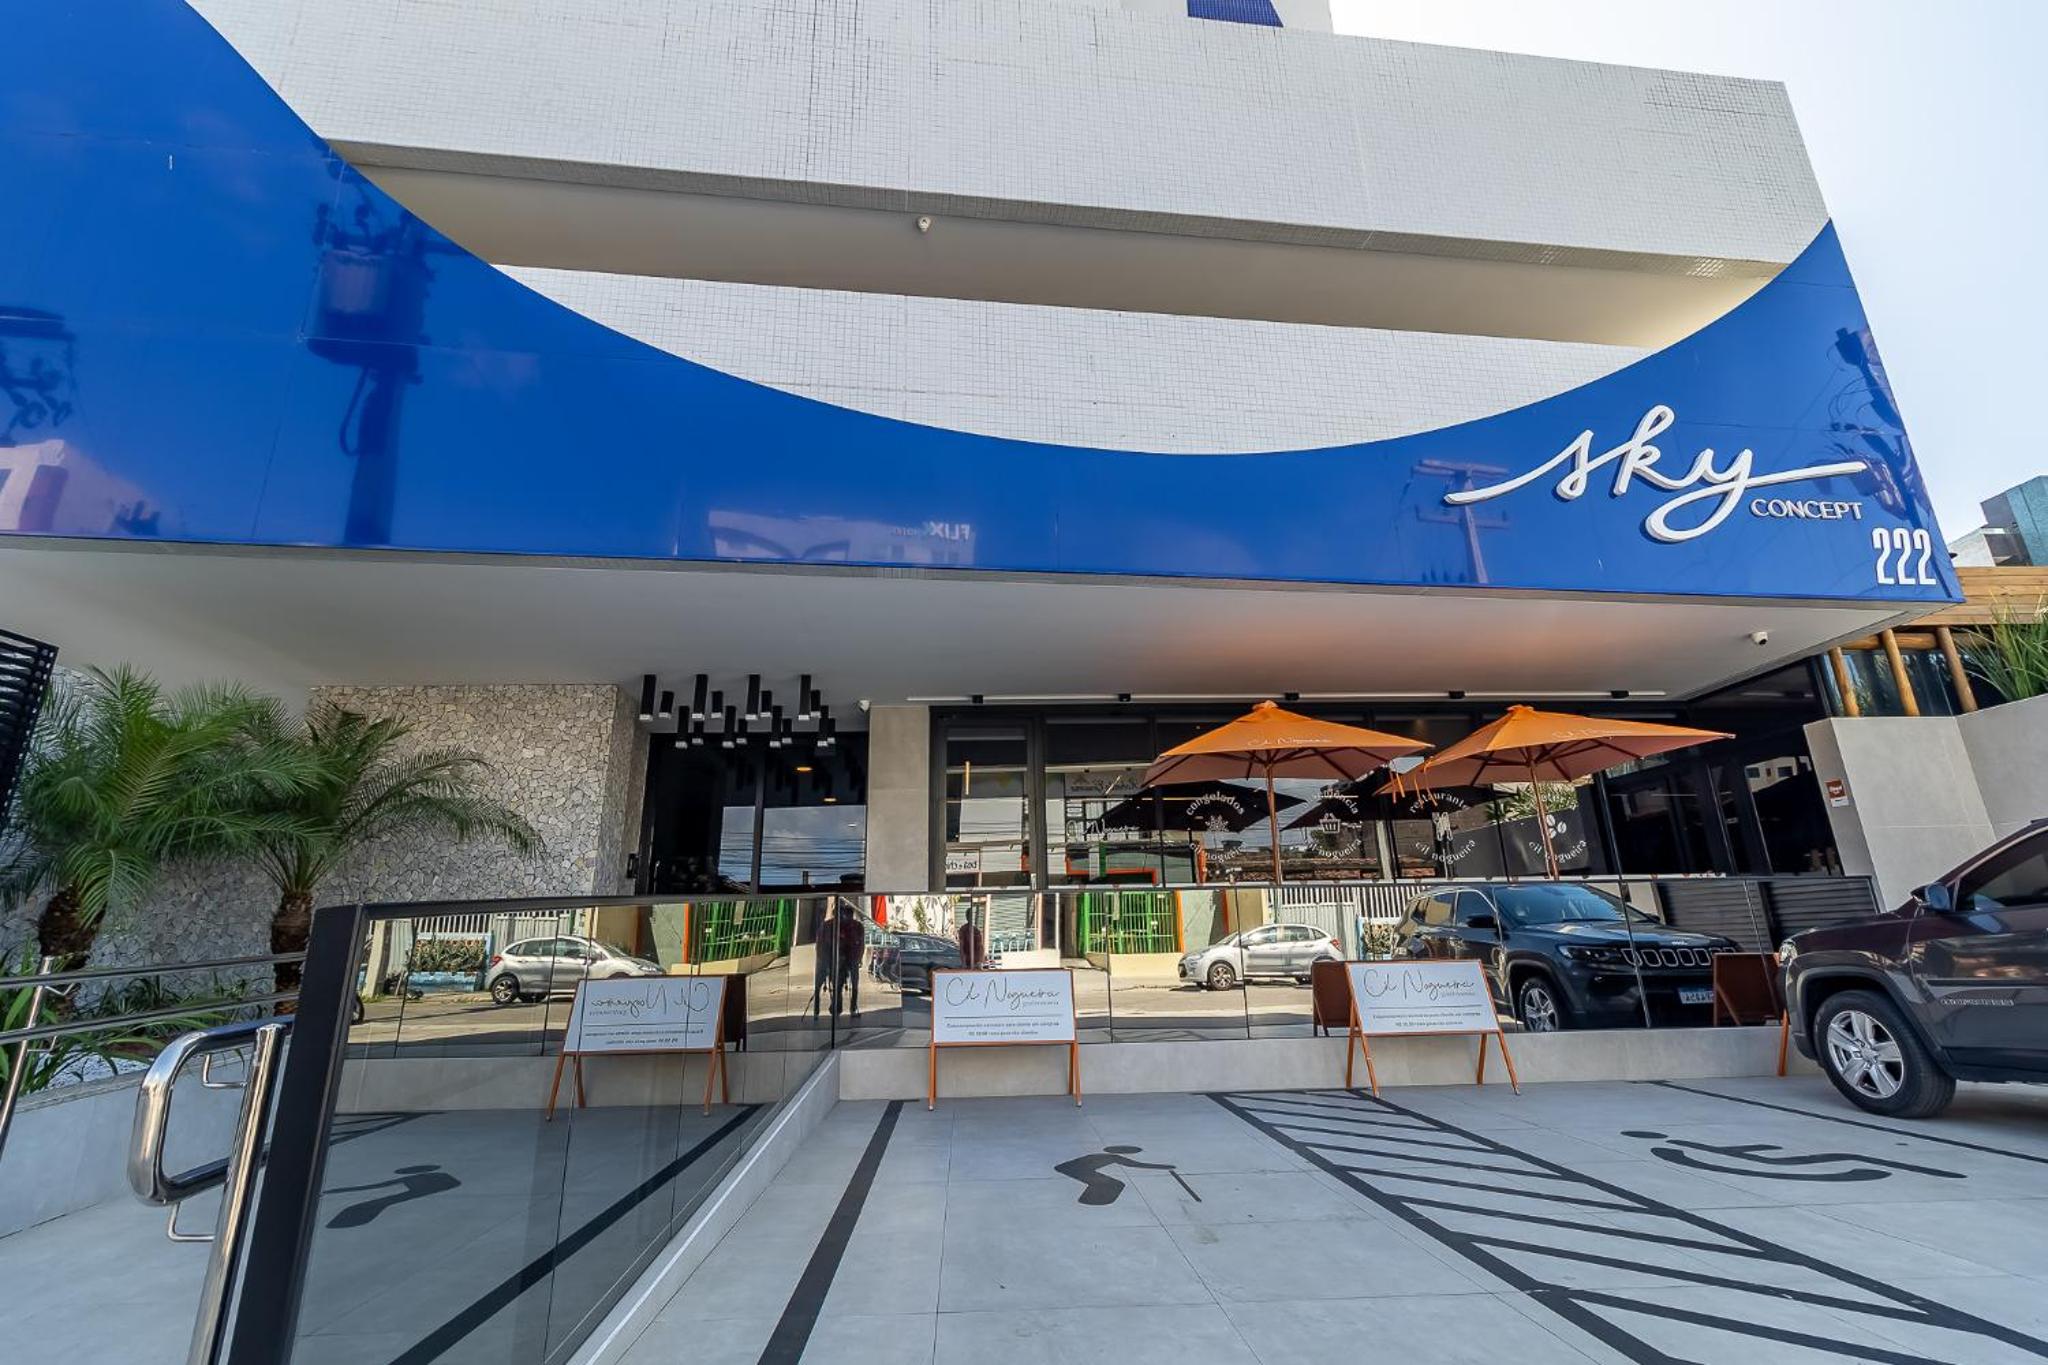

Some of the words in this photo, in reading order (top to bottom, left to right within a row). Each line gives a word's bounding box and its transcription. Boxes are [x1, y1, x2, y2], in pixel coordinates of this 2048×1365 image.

[1443, 404, 1868, 542] sky
[1750, 498, 1864, 522] CONCEPT
[1872, 527, 1937, 586] 222
[1186, 790, 1246, 817] congelados
[1319, 838, 1362, 861] nogueira
[1431, 839, 1476, 865] nogueira
[983, 975, 1061, 1011] Nogueira
